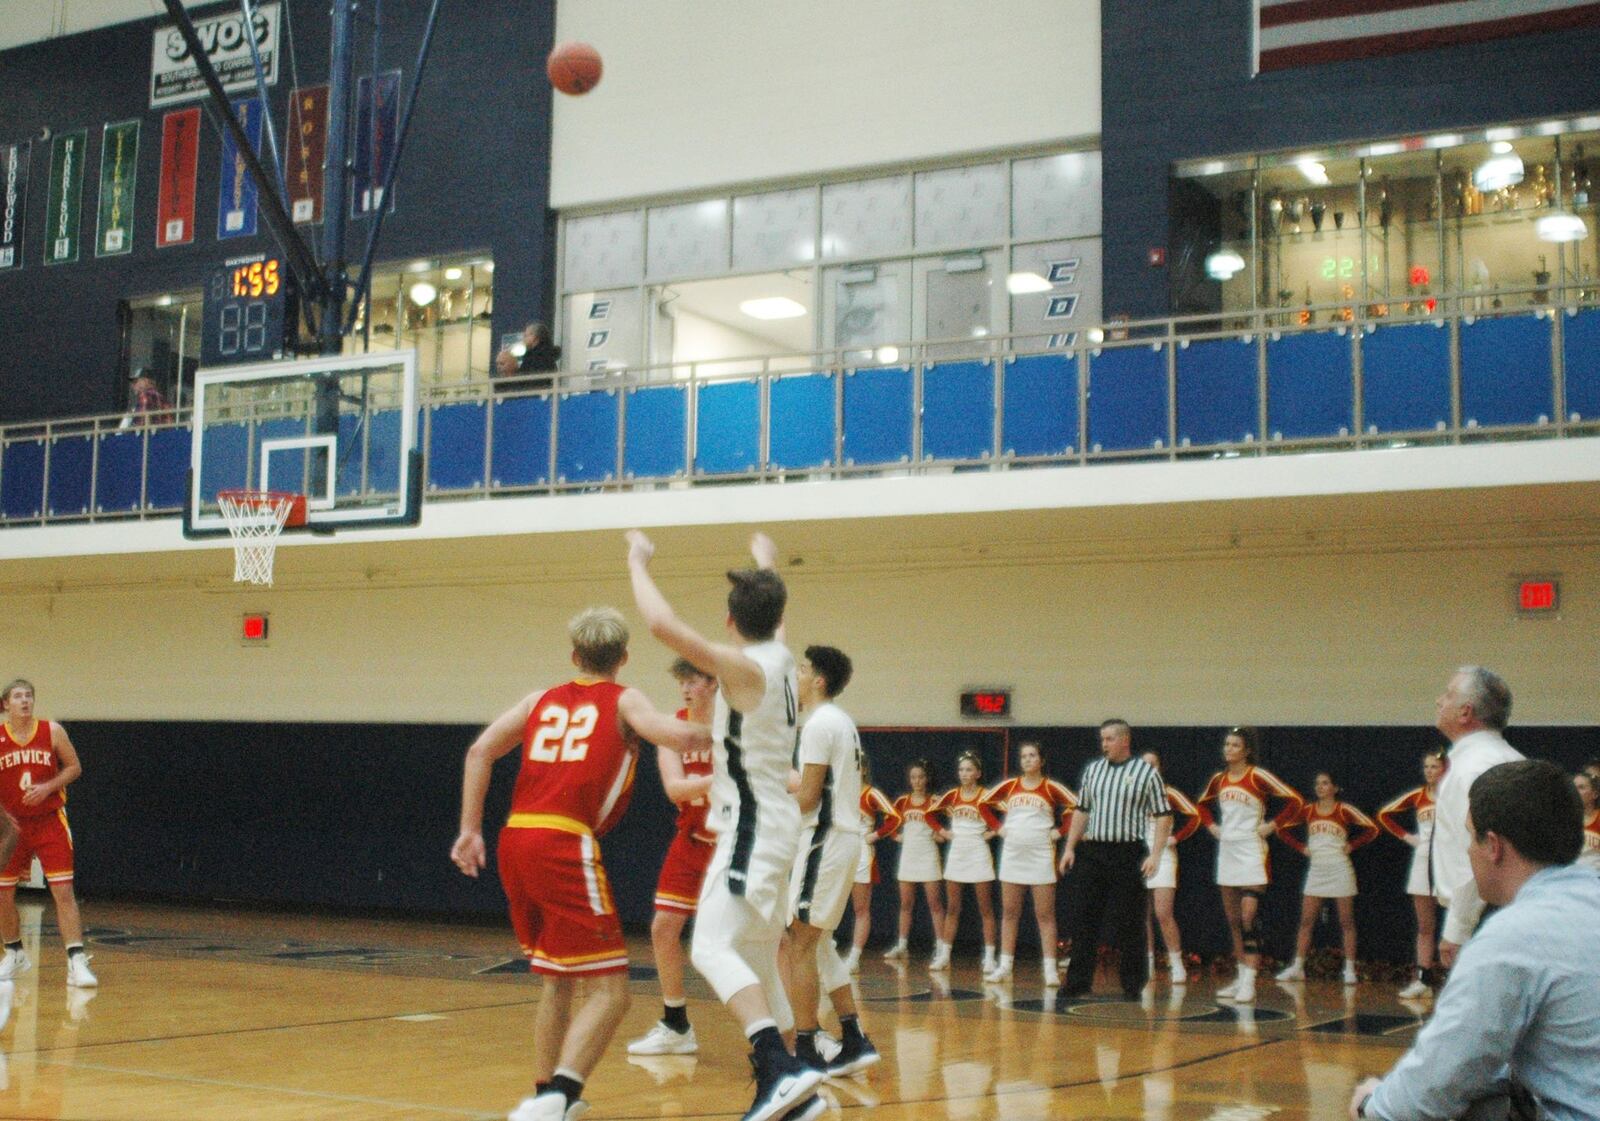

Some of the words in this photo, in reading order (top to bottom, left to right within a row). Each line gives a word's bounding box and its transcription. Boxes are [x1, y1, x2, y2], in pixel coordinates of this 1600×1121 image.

[4, 146, 18, 243] EDGEWOOD
[59, 139, 74, 237] HARRISON
[528, 704, 600, 763] 22
[19, 771, 34, 792] 4
